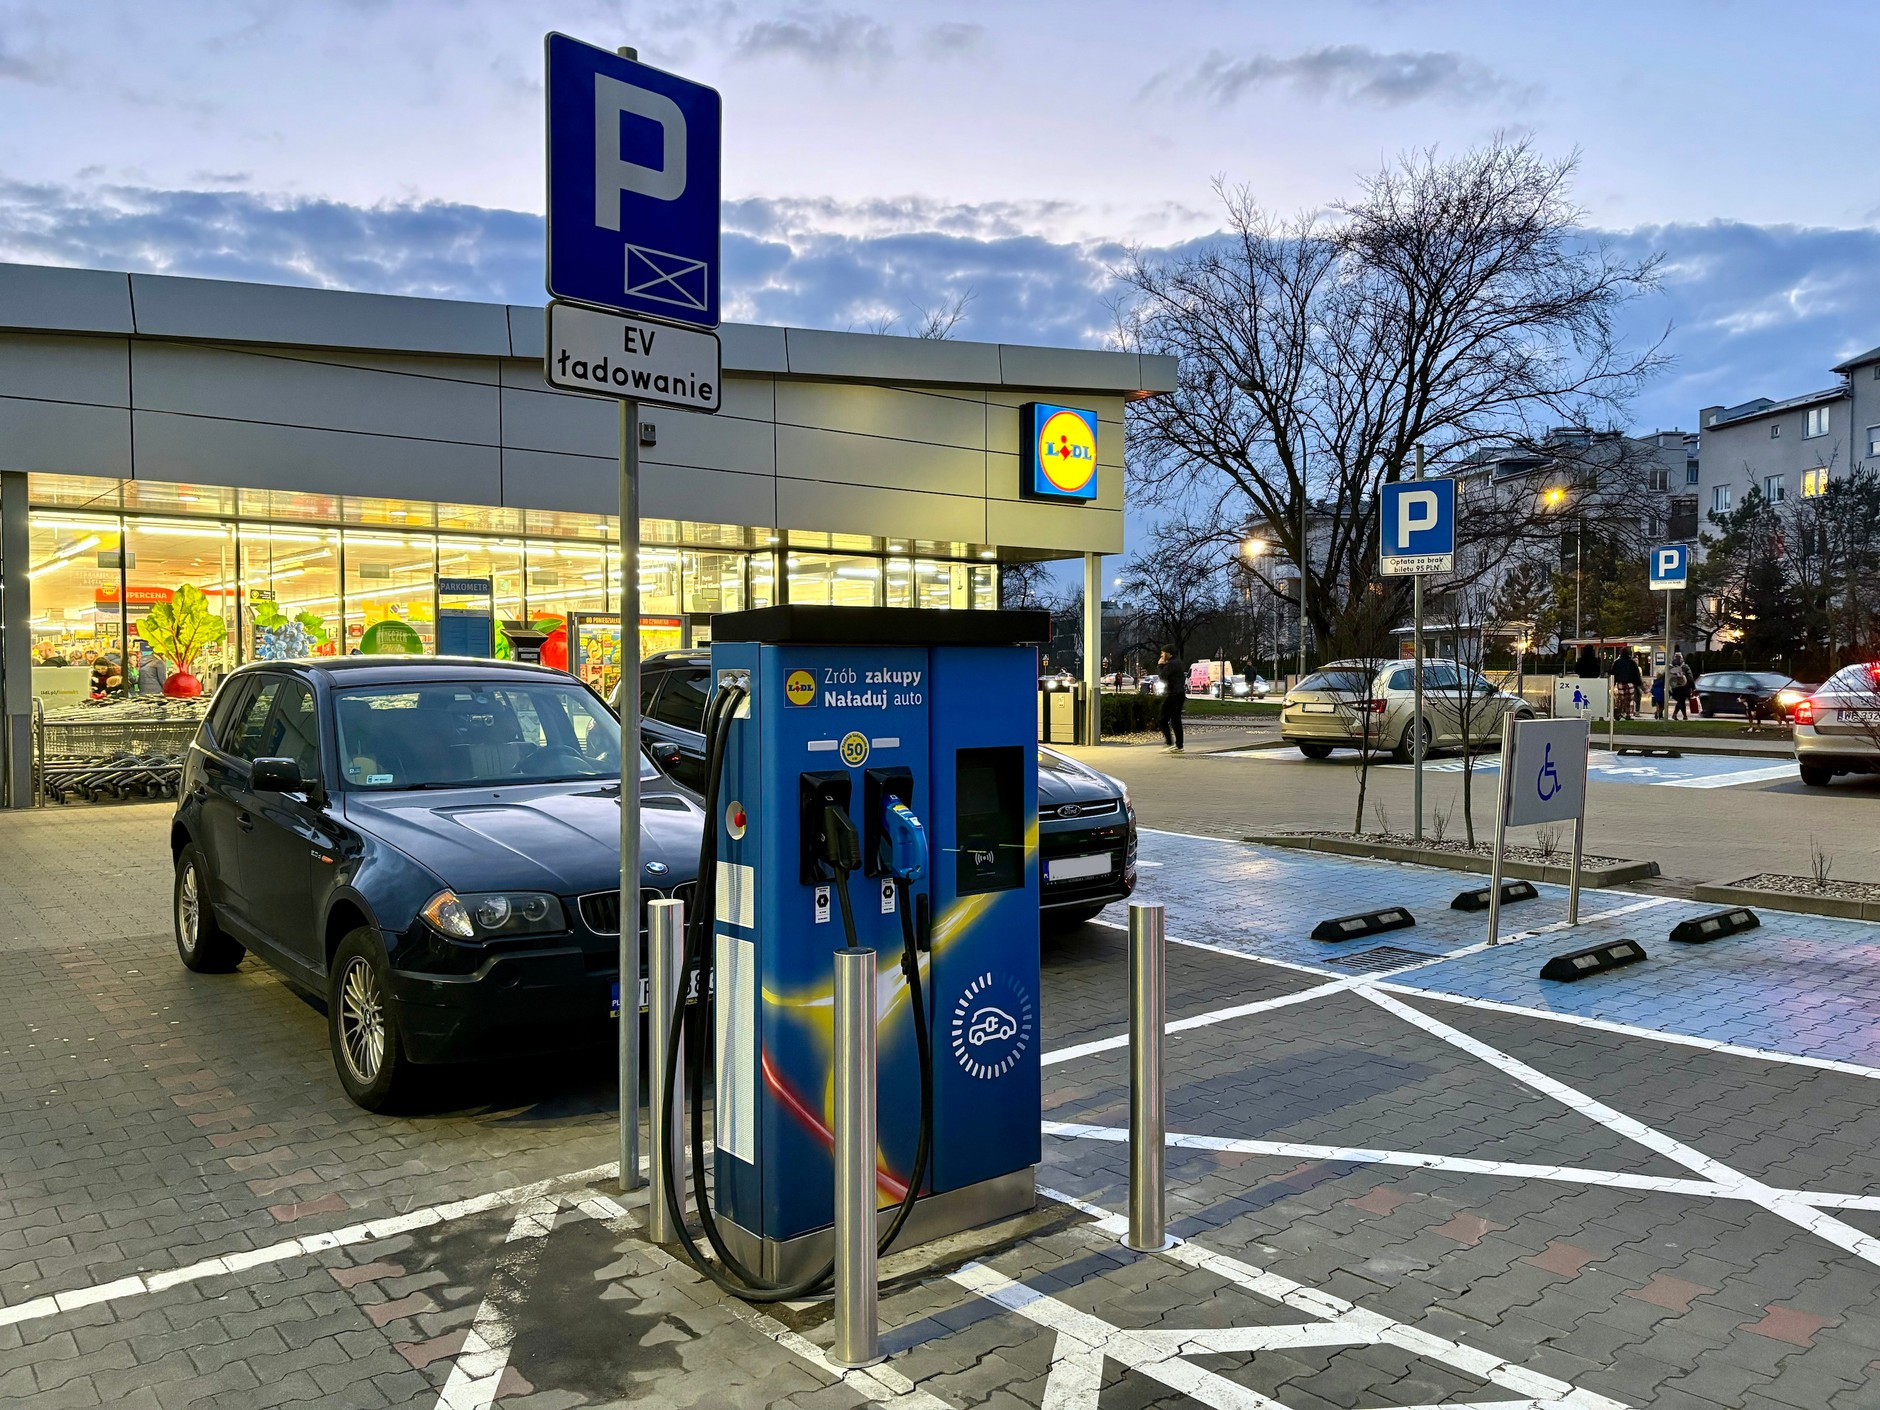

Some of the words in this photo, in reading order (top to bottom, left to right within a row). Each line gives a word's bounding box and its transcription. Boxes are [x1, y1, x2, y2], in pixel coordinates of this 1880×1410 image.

[595, 72, 687, 231] P
[624, 325, 656, 356] EV
[557, 348, 713, 401] ładowanie
[1398, 490, 1438, 548] P
[1658, 549, 1679, 578] P
[125, 591, 168, 599] PERCENA
[440, 582, 488, 591] PARKOMETR
[824, 667, 857, 684] Zrób
[865, 667, 921, 687] zakupy
[824, 689, 887, 710] Naładuj
[893, 691, 922, 705] auto
[847, 742, 863, 757] 50
[1063, 806, 1079, 815] Ford
